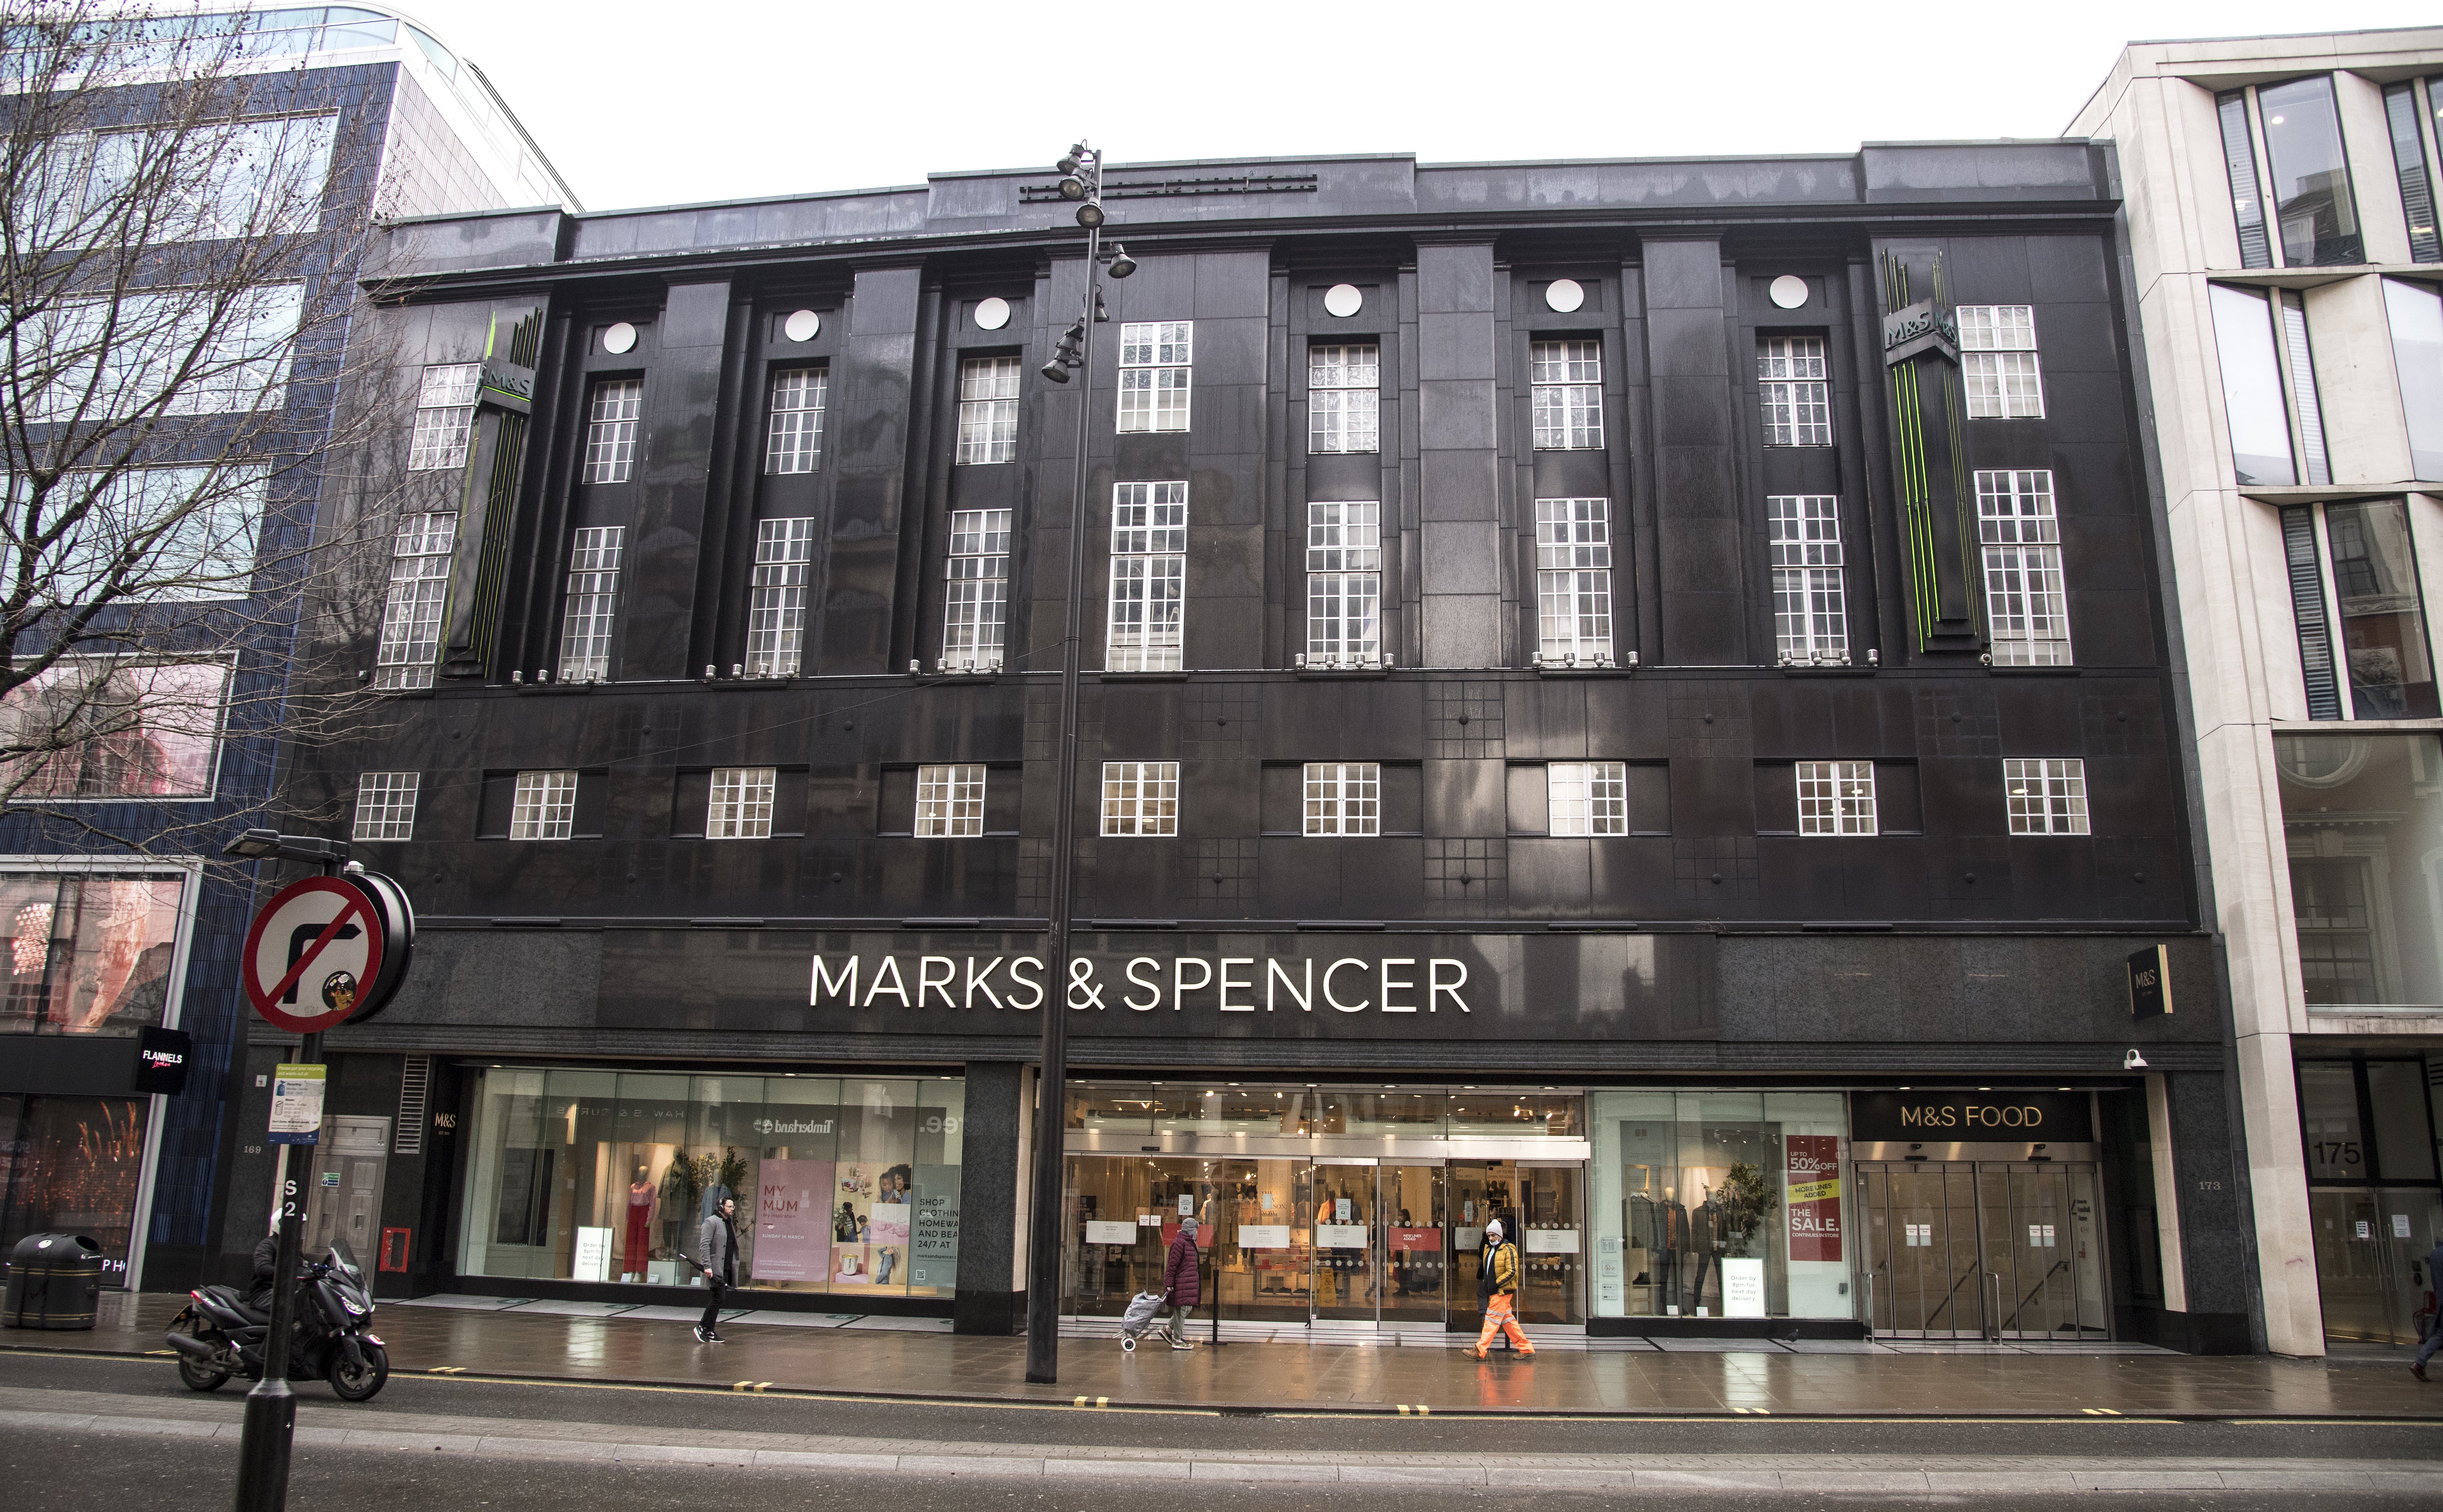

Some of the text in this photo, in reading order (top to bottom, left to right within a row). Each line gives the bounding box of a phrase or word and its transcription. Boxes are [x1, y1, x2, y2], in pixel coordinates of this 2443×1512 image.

[1888, 312, 1929, 345] M&S
[487, 368, 530, 395] M&S
[810, 955, 1470, 1012] MARKS & SPENCER
[2135, 969, 2155, 989] M&S
[143, 1050, 182, 1064] FLANNELS
[152, 1060, 171, 1068] London
[435, 1112, 456, 1128] M&S
[1901, 1106, 2042, 1127] M&S FOOD
[2314, 1142, 2361, 1165] 175
[1791, 1157, 1820, 1170] 50%
[285, 1180, 297, 1195] S
[764, 1185, 785, 1196] MY
[2199, 1181, 2221, 1191] 173
[285, 1201, 296, 1216] 2
[763, 1200, 798, 1211] MUM
[1791, 1208, 1811, 1217] THE
[1791, 1218, 1839, 1231] SALE.
[918, 1240, 937, 1249] 24/7
